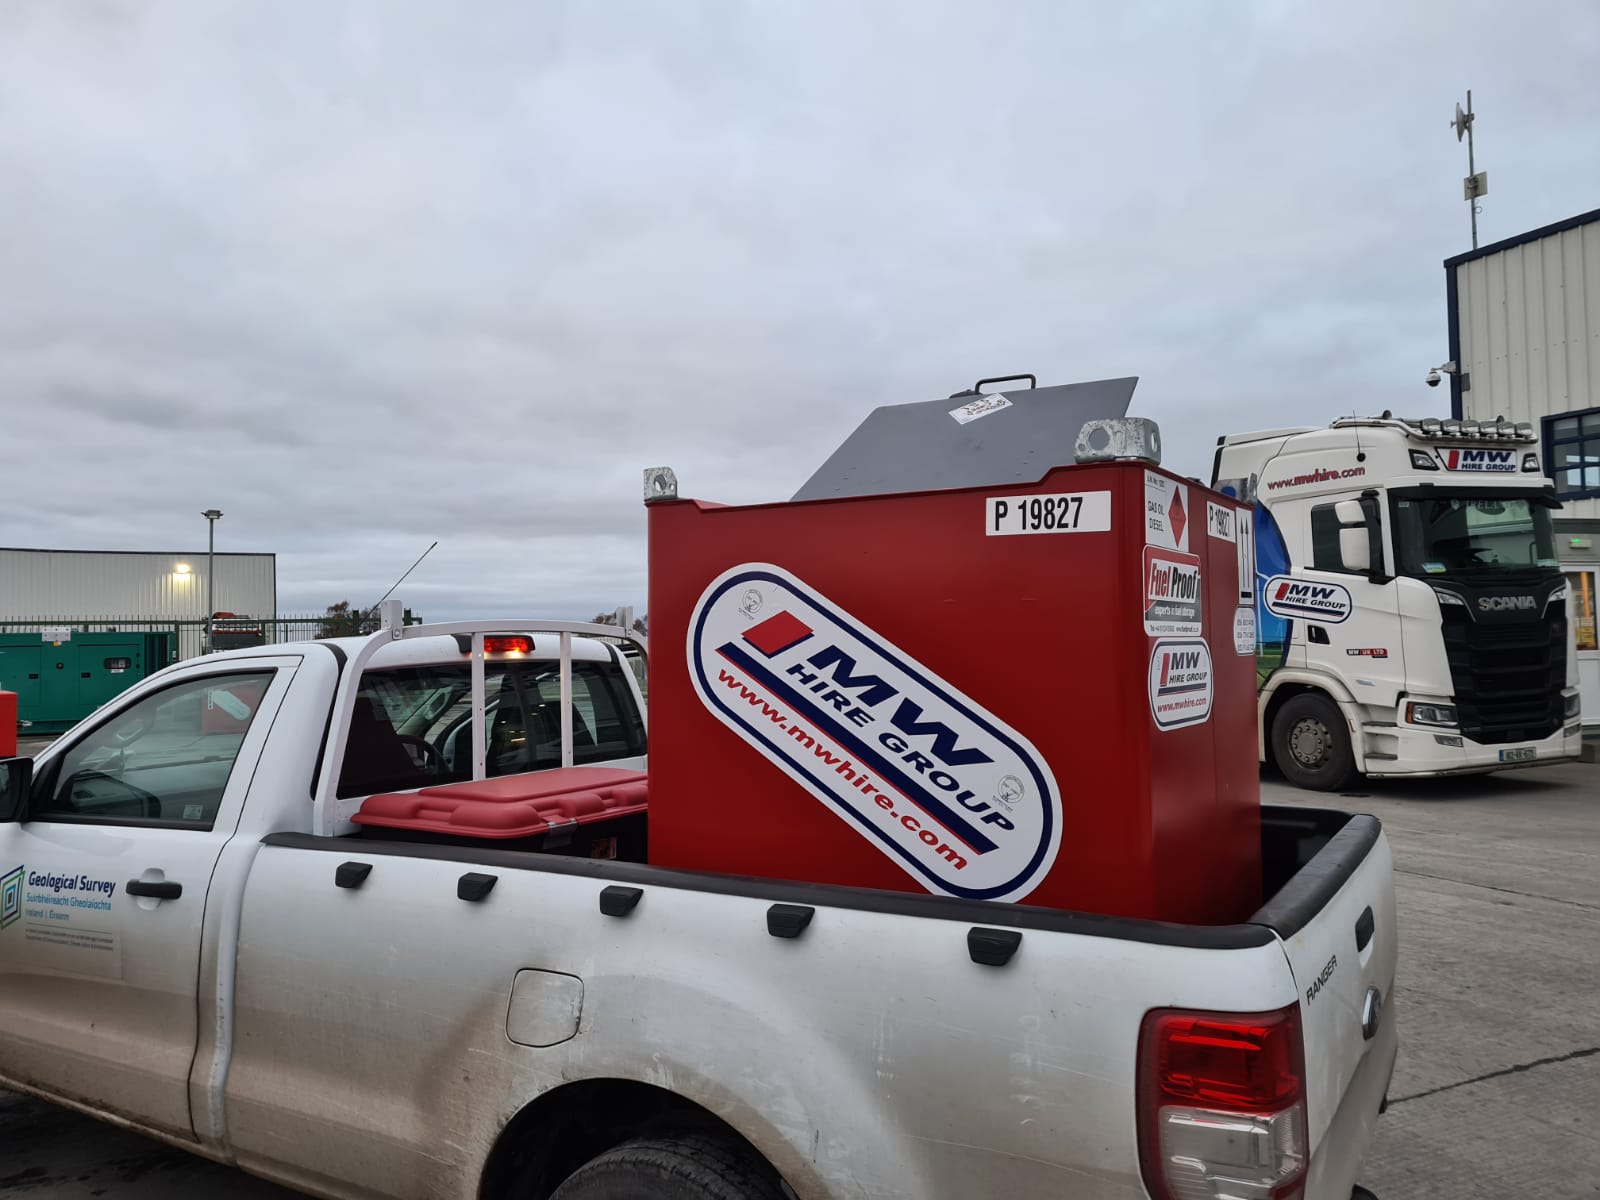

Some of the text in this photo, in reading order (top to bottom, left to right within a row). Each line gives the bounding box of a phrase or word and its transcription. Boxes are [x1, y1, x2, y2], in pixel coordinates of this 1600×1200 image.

[1462, 450, 1512, 463] MW
[1485, 463, 1516, 471] GROUP
[1267, 467, 1366, 491] www.mwhire.com
[995, 496, 1083, 531] P 19827
[1147, 500, 1158, 514] GAS
[1149, 517, 1164, 532] DIESEL
[1209, 505, 1214, 533] P
[1150, 562, 1198, 600] Fuel Proof
[1288, 584, 1336, 600] MW
[1285, 595, 1347, 610] HIRE GROUP
[1478, 595, 1537, 611] SCANIA
[1170, 651, 1200, 671] MW
[1168, 671, 1207, 684] HIRE GROUP
[806, 644, 995, 767] MW
[1157, 697, 1207, 713] www.mwhire.com
[785, 663, 1015, 831] HIRE GROUP
[717, 669, 968, 871] www.mwhire.com
[28, 871, 116, 898] Geological Survey
[1306, 954, 1338, 1006] RANGER
